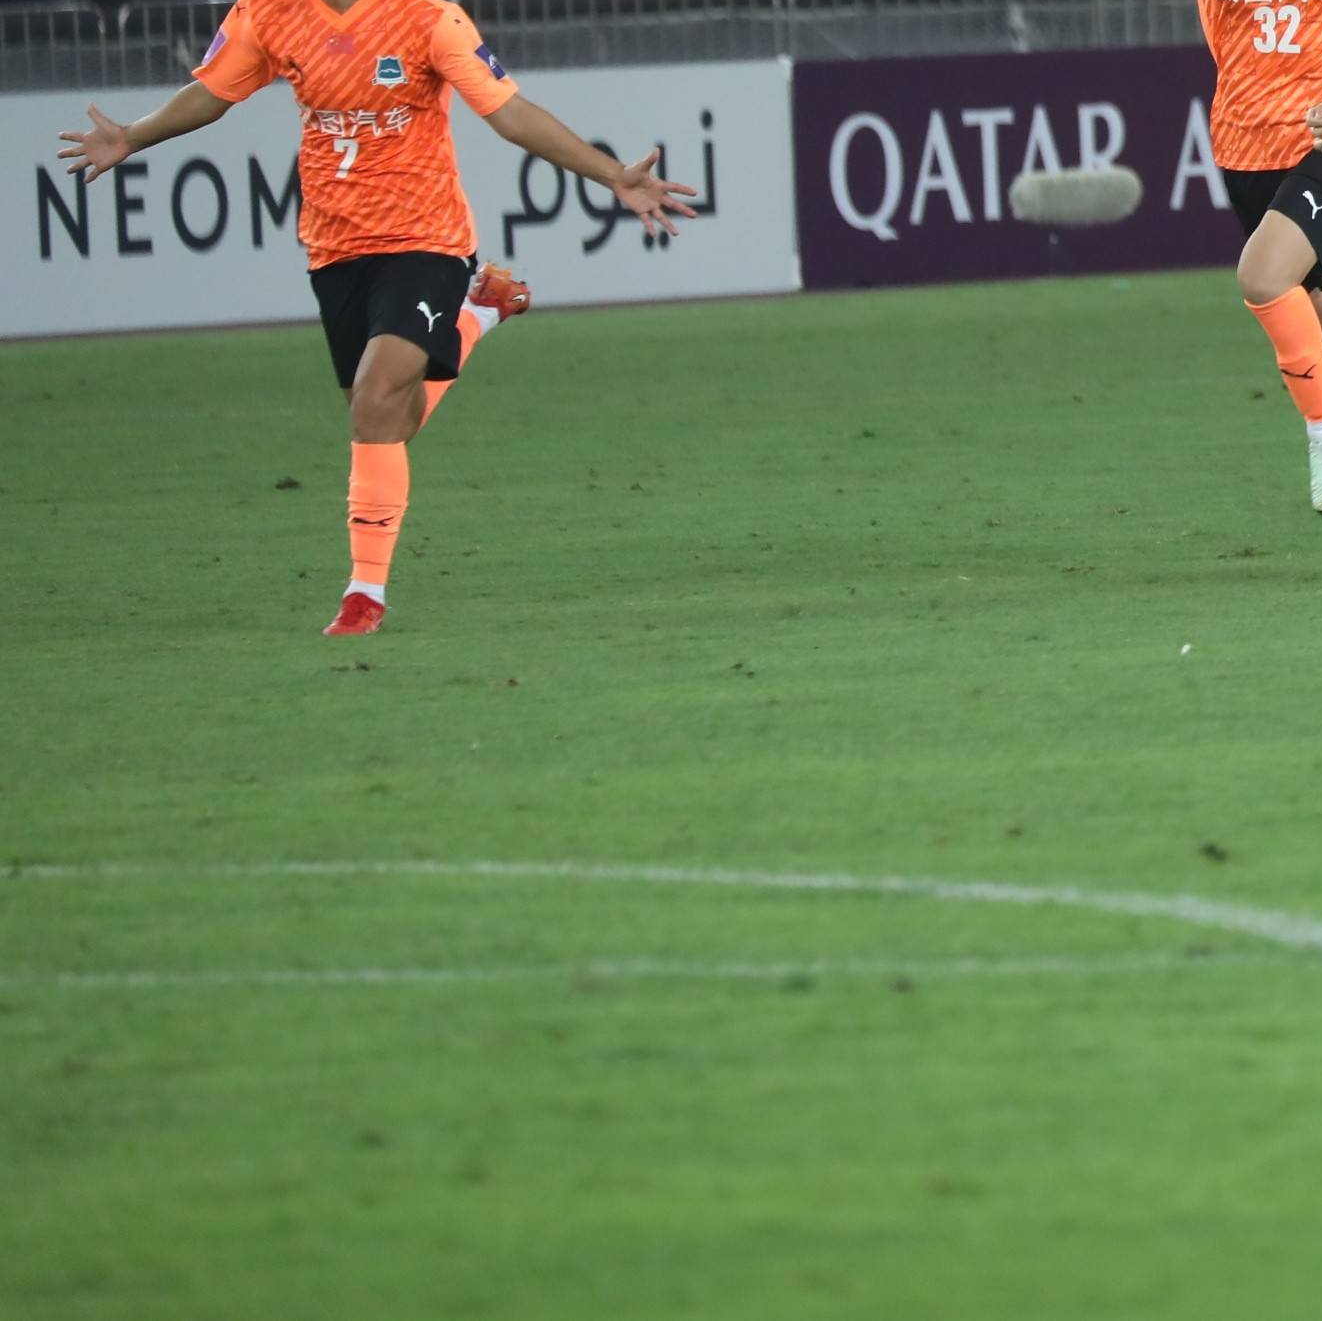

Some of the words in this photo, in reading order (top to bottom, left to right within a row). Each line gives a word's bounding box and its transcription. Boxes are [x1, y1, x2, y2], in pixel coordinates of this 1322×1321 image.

[1253, 5, 1301, 54] 32
[302, 105, 413, 137] 图汽车
[333, 139, 359, 178] 7
[829, 101, 1127, 241] QATAR
[36, 152, 304, 261] NEOM
